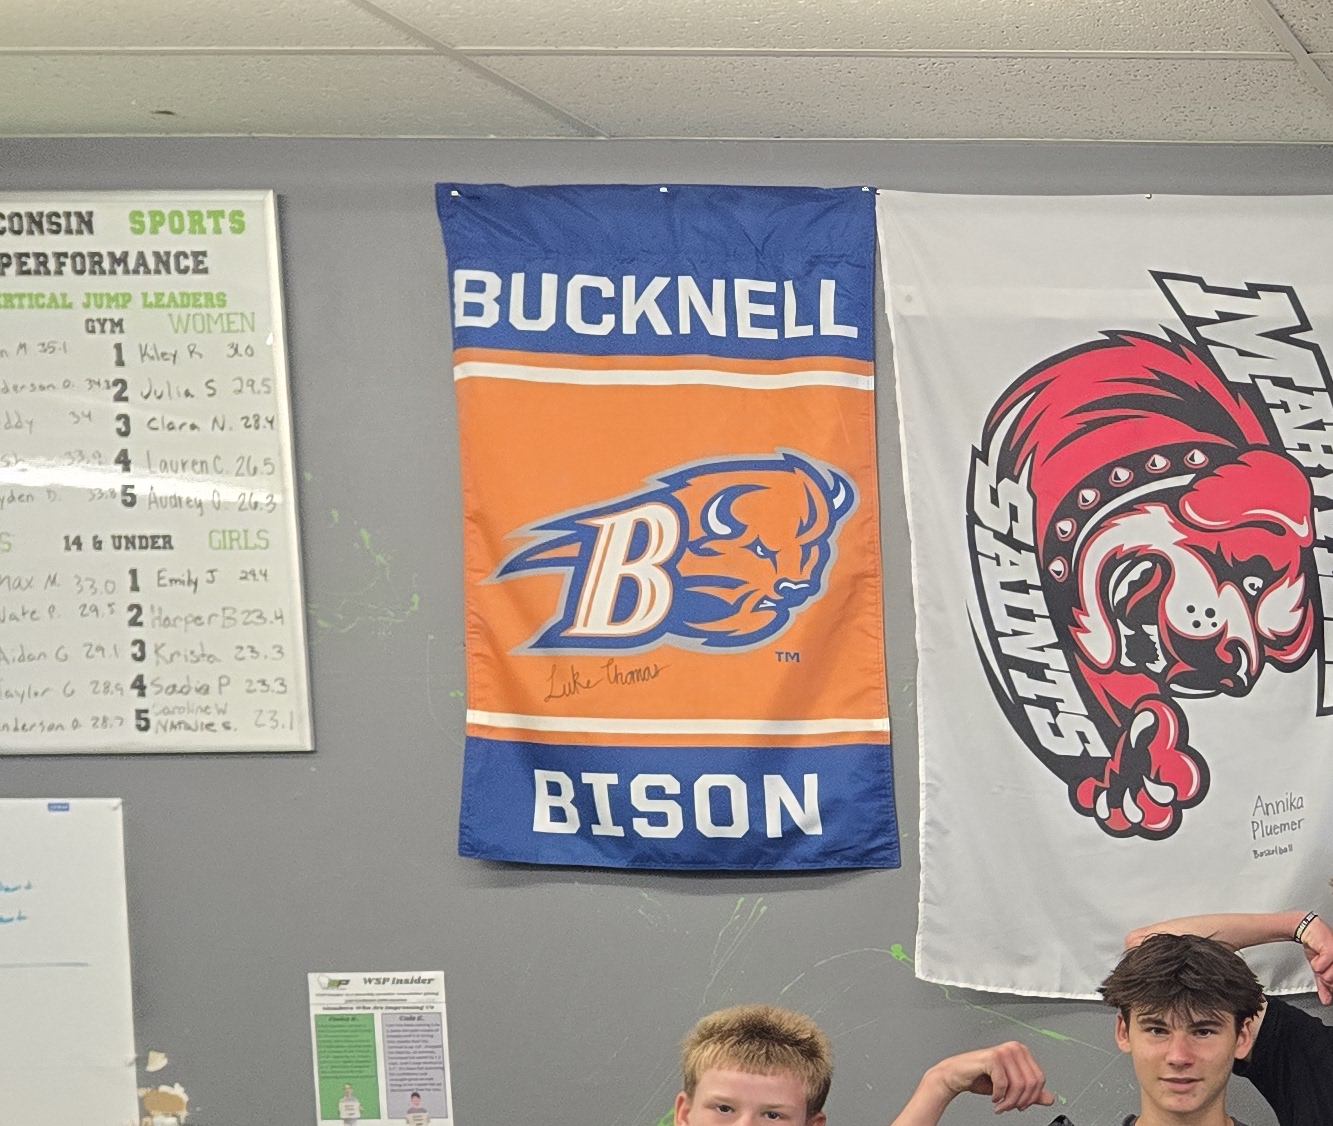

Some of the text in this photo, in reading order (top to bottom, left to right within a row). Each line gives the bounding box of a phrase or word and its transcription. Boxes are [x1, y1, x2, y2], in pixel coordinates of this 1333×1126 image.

[129, 209, 246, 235] SPORTS
[0, 250, 209, 276] PERFORMANCE
[0, 291, 227, 310] RTICAL JUMP LEADERS
[453, 268, 859, 340] BUCKNELL
[84, 318, 125, 334] GYM
[168, 312, 256, 334] WOMEN
[113, 342, 126, 368] 1
[112, 376, 273, 403] 2 Julia S 29.5
[115, 413, 131, 438] 3
[147, 414, 200, 432] Clara
[240, 413, 276, 432] 28.4
[114, 448, 132, 472] 4
[146, 450, 209, 475] Lauren
[235, 455, 276, 478] 26.5
[121, 484, 138, 508] 5
[147, 486, 205, 517] Audrey
[237, 491, 278, 514] 26.3
[63, 534, 82, 552] 14
[110, 533, 174, 551] UNDER
[208, 529, 270, 551] GIRLS
[128, 568, 140, 592] 1
[156, 567, 199, 595] Emily
[558, 502, 801, 663] B TM
[967, 446, 1112, 760] SAINTS
[127, 603, 285, 634] 2 Harper B 23.4
[131, 638, 286, 667] 3 Krista 23.3
[0, 677, 52, 704] aylor
[130, 673, 147, 697] 4
[218, 673, 231, 695] P
[245, 676, 288, 695] 23.3
[135, 708, 150, 732] 5
[254, 708, 294, 732] 23.1
[532, 768, 823, 839] BISON
[1252, 791, 1305, 816] Annika
[1251, 818, 1306, 841] Pluemer
[363, 975, 435, 986] WSP Insider
